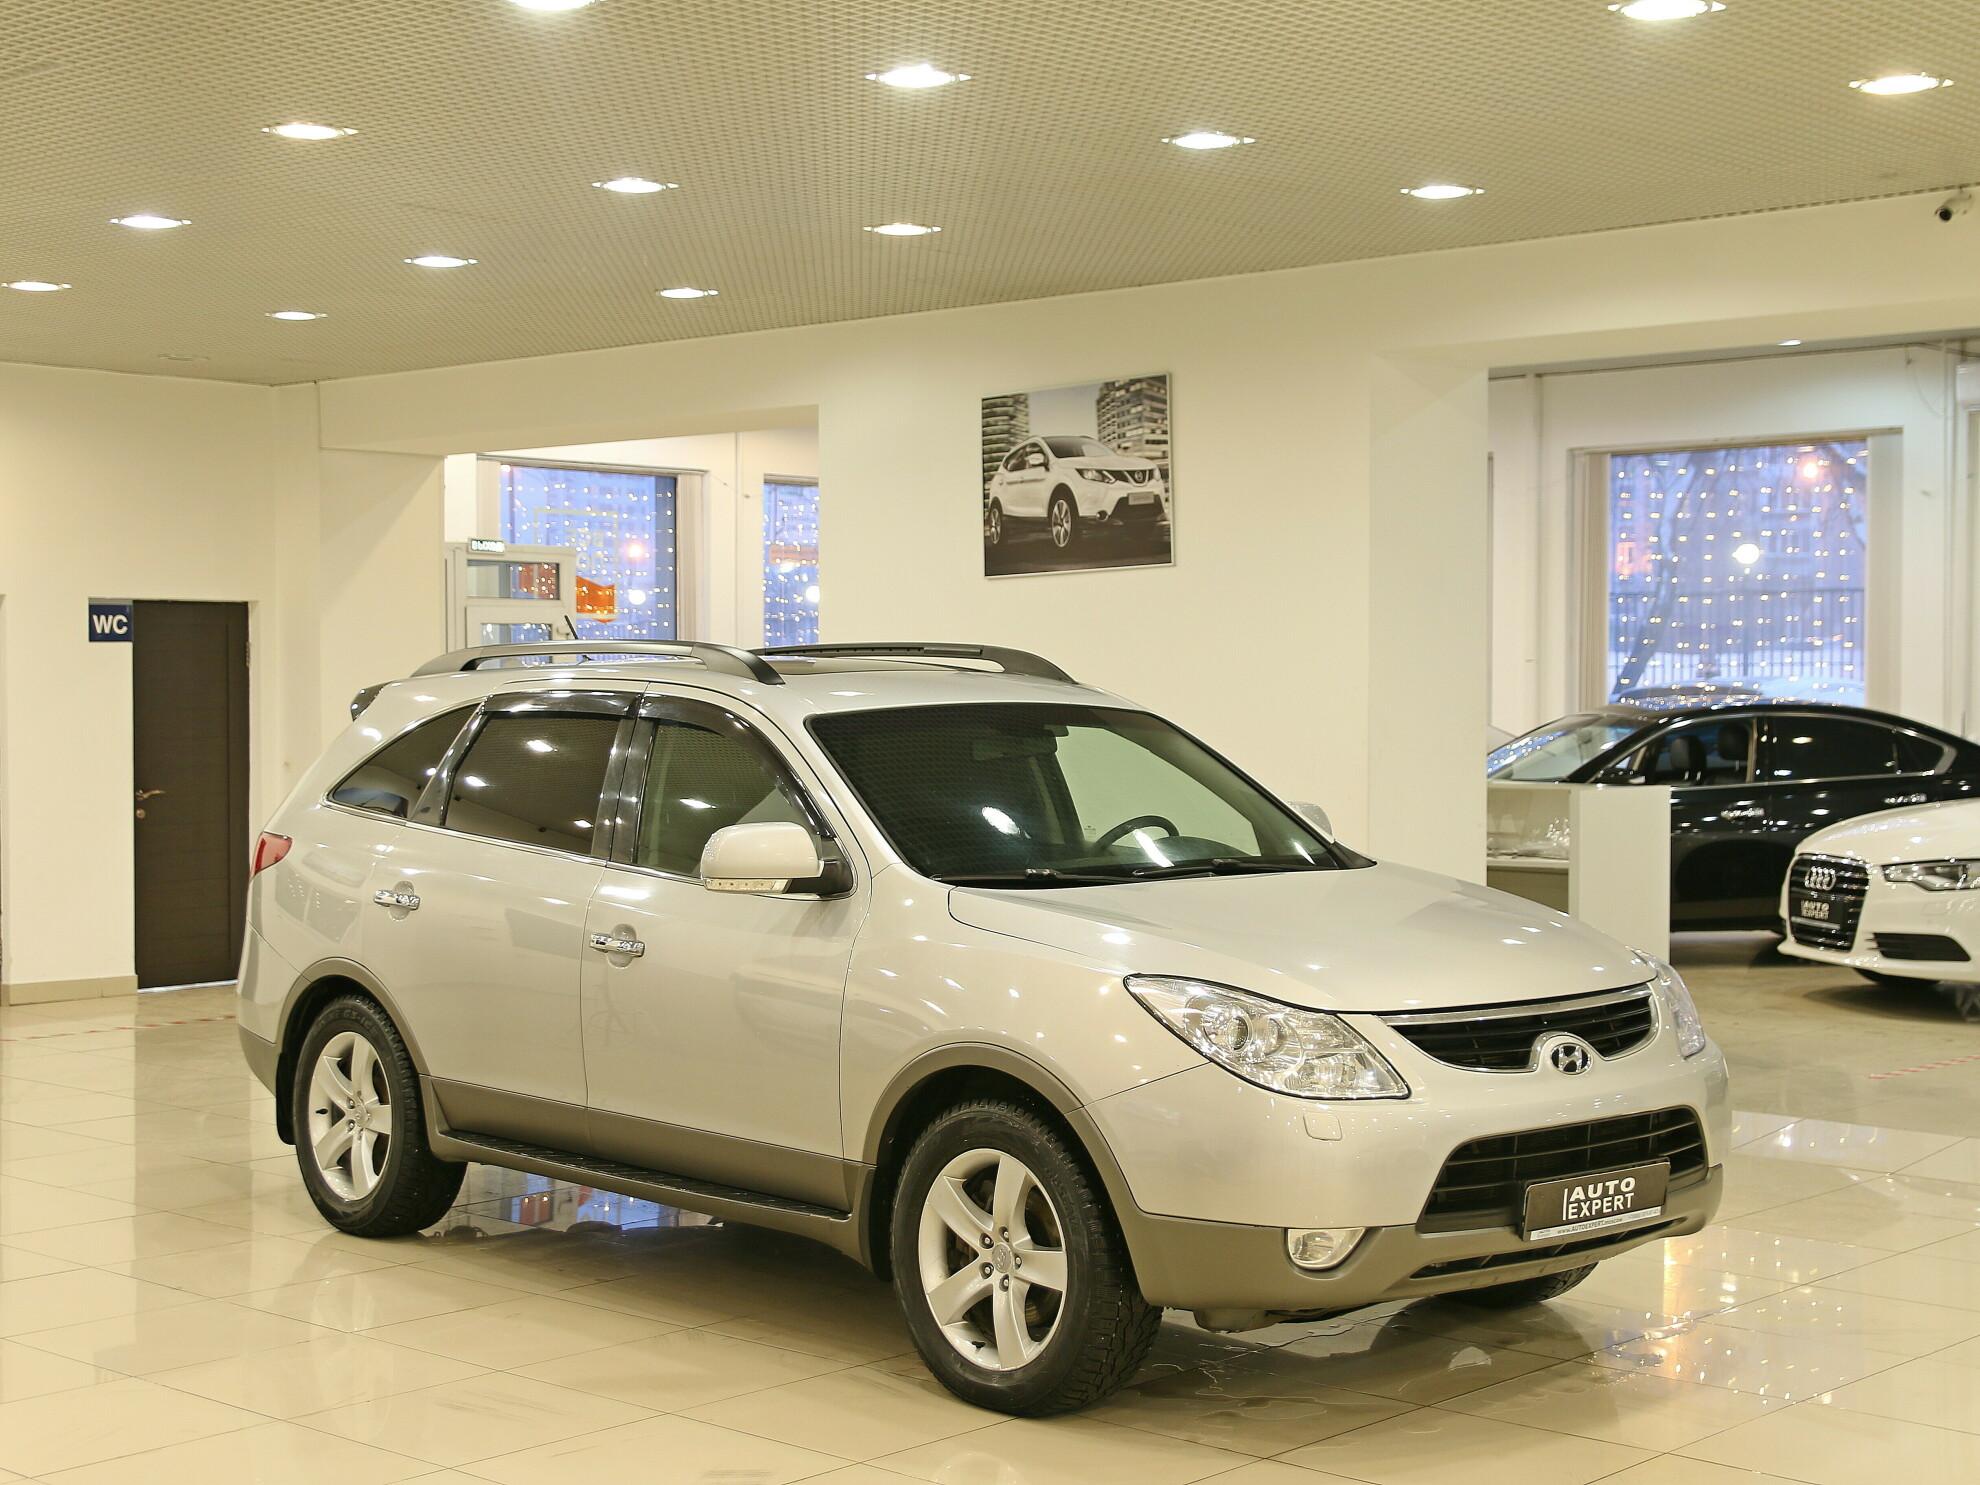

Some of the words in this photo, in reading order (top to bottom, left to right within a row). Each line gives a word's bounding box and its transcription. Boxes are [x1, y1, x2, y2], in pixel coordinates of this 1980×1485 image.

[92, 614, 128, 635] WC
[1570, 1177, 1636, 1202] AUTO
[1568, 1192, 1635, 1220] EXPERT
